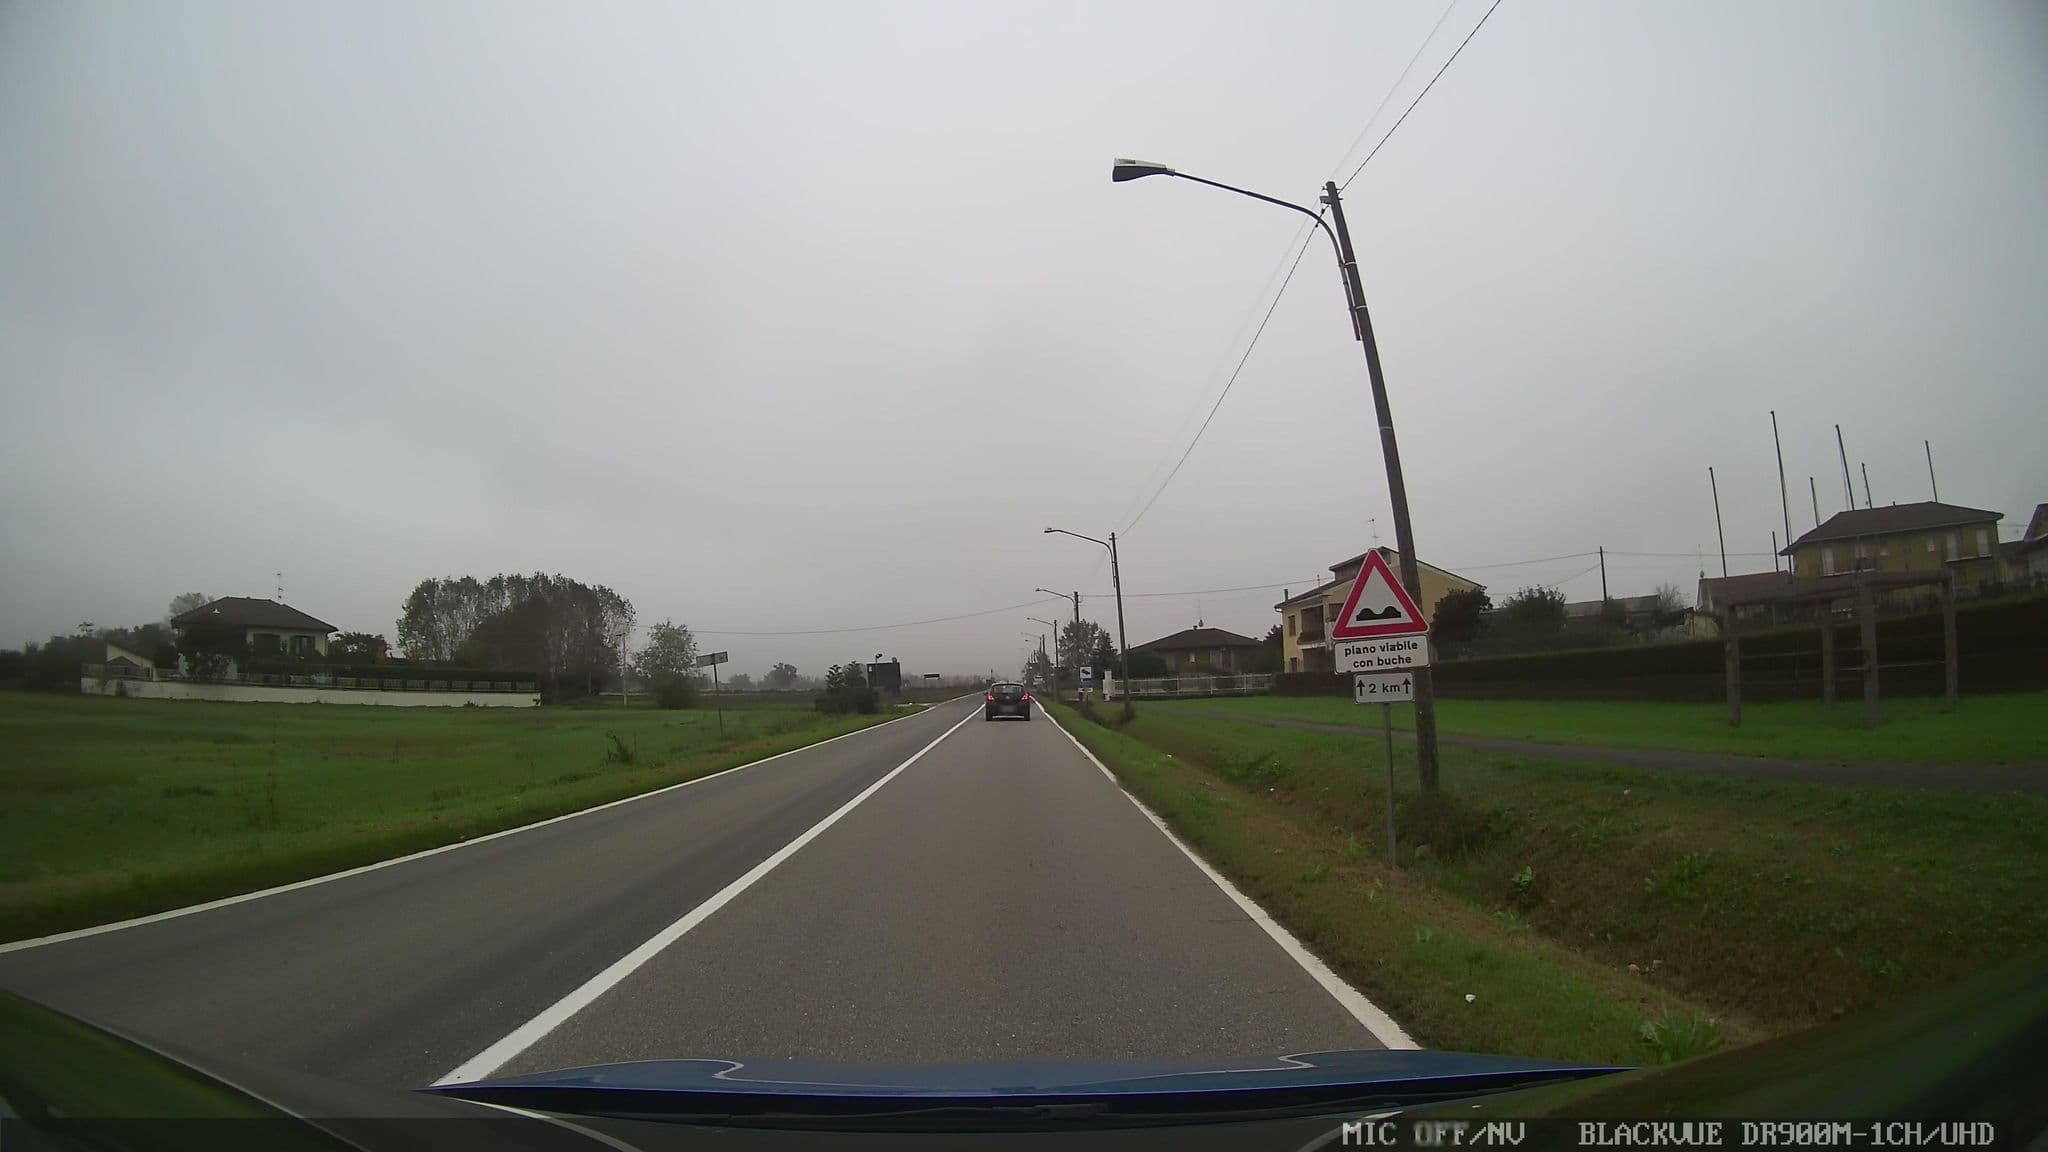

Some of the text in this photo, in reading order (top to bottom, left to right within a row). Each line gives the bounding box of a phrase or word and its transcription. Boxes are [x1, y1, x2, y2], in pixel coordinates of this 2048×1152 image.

[1344, 640, 1418, 657] piano viabile
[1353, 655, 1412, 668] con buche
[1368, 683, 1400, 694] 2 km
